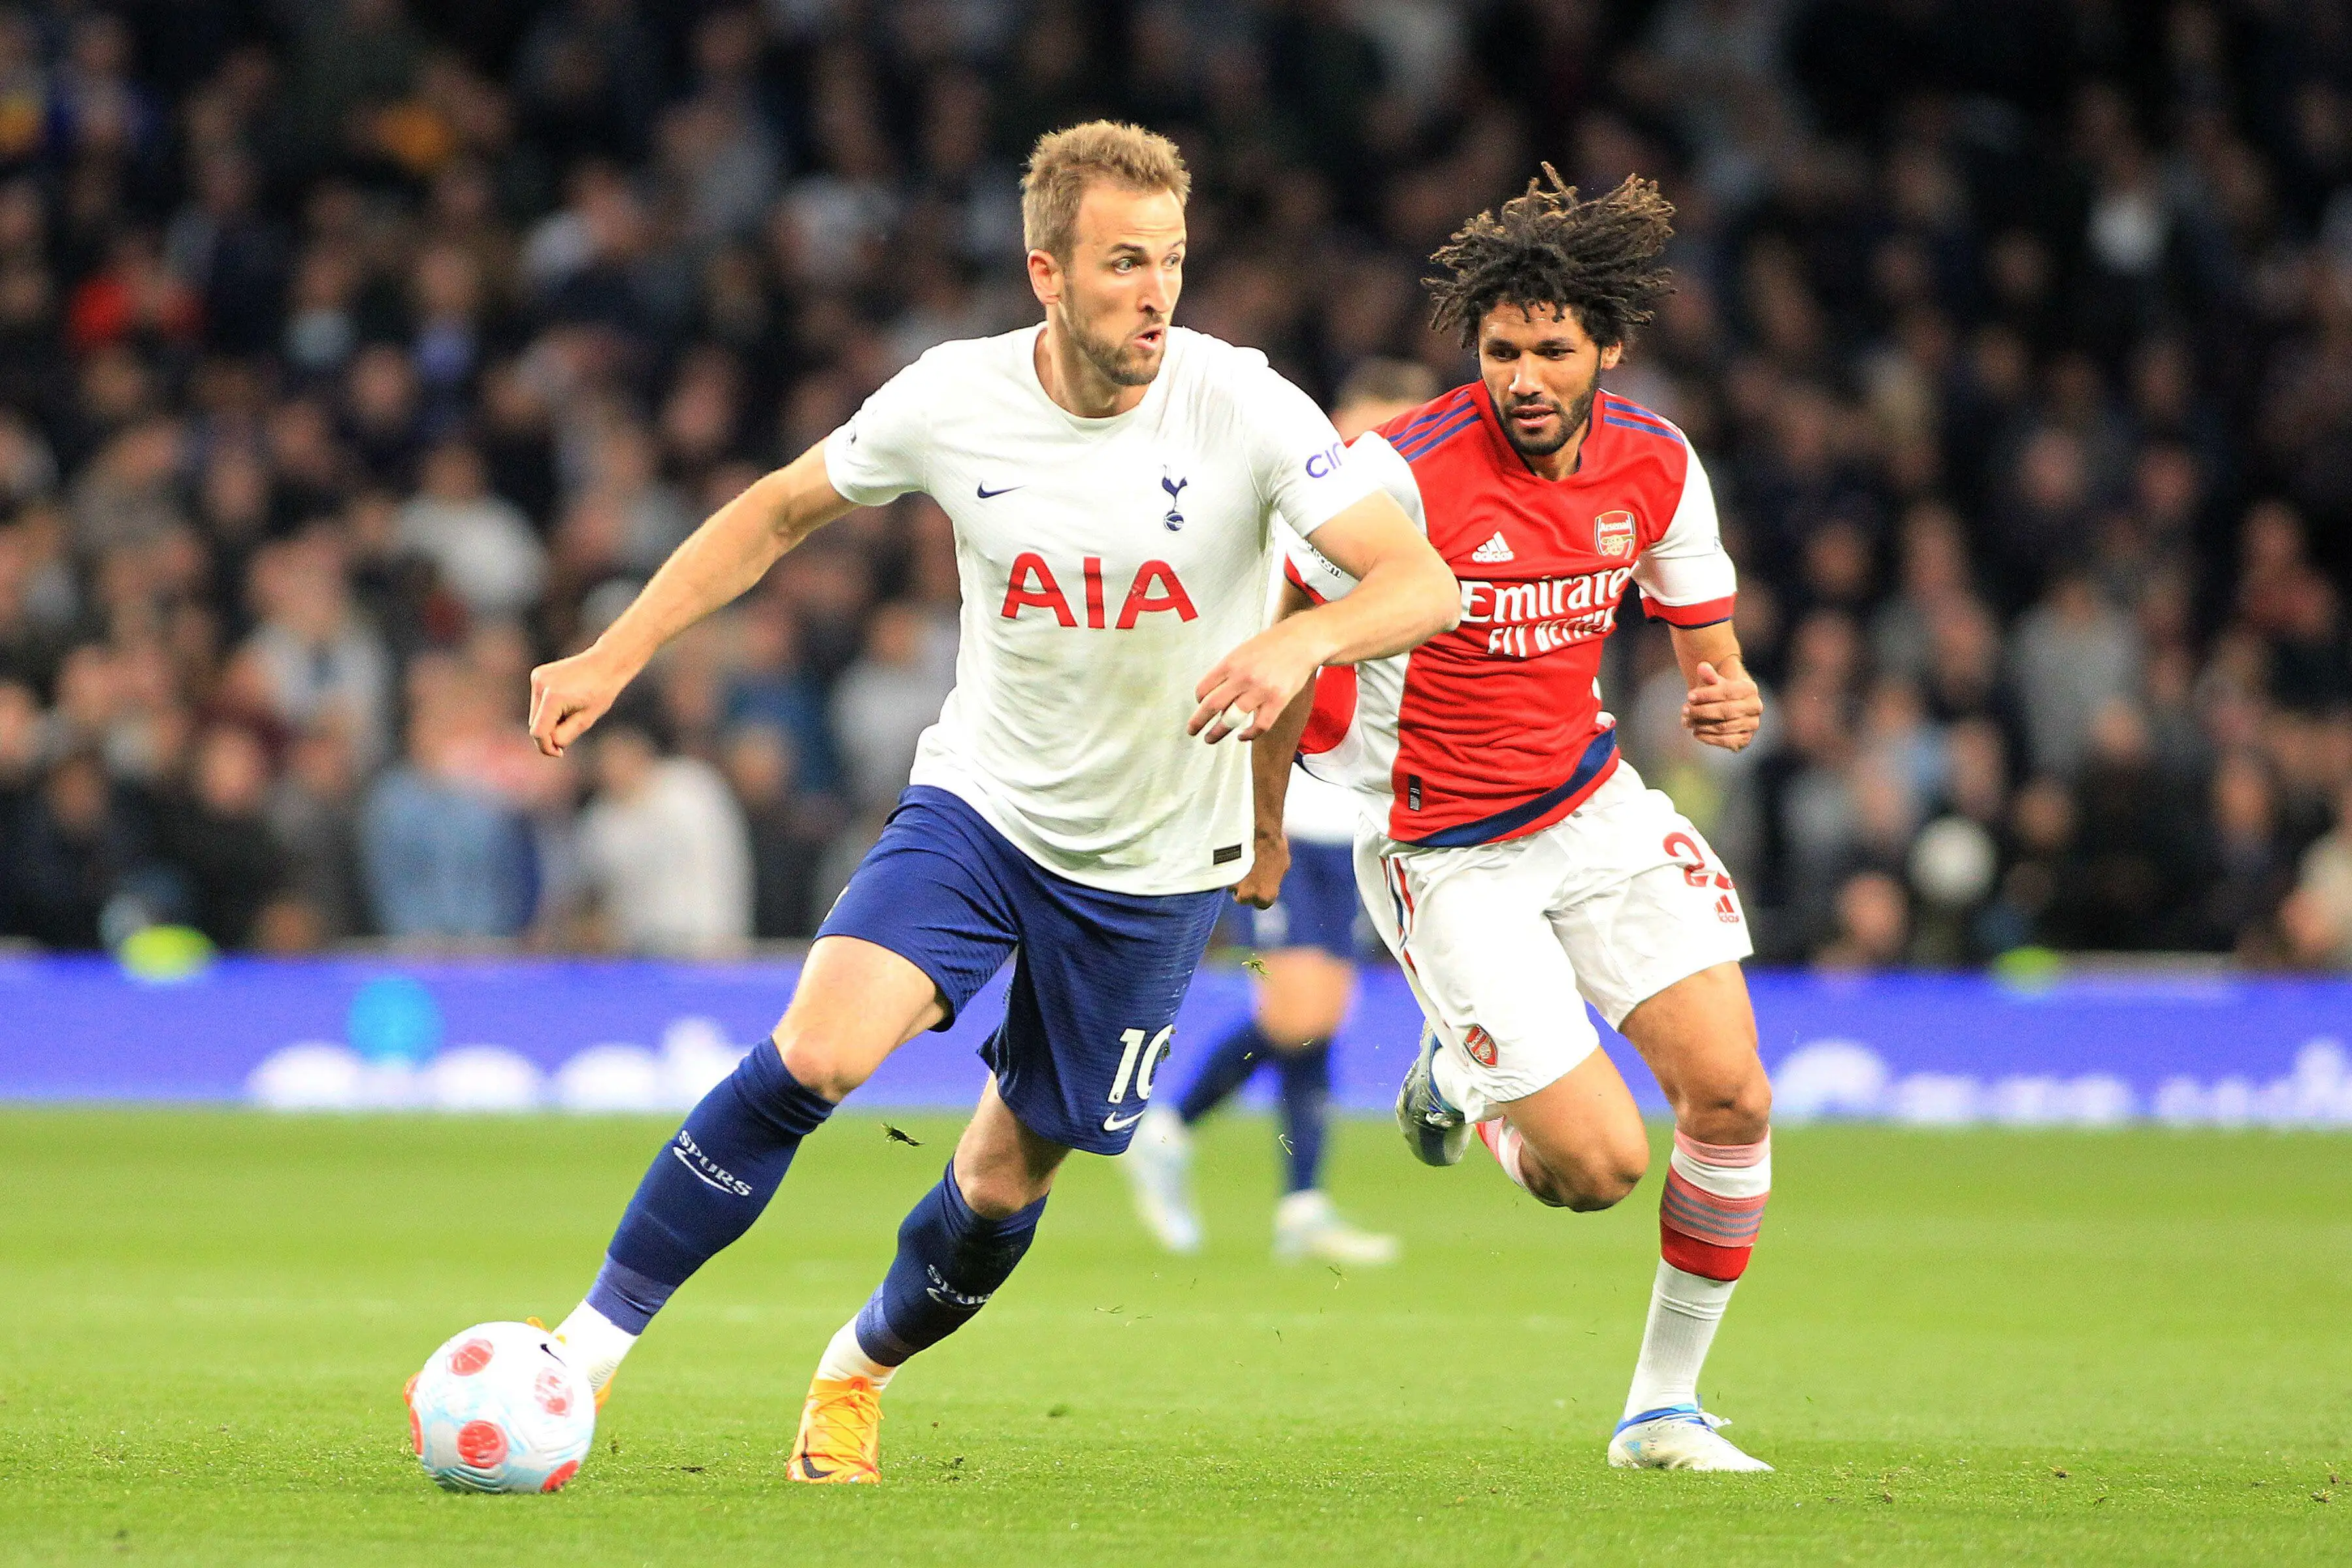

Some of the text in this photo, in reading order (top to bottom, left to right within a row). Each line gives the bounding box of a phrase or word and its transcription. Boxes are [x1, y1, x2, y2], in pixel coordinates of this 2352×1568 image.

[1001, 551, 1199, 629] AIA
[1460, 559, 1639, 623] Emirate
[1107, 1024, 1173, 1104] 10
[679, 1130, 753, 1196] SPURS
